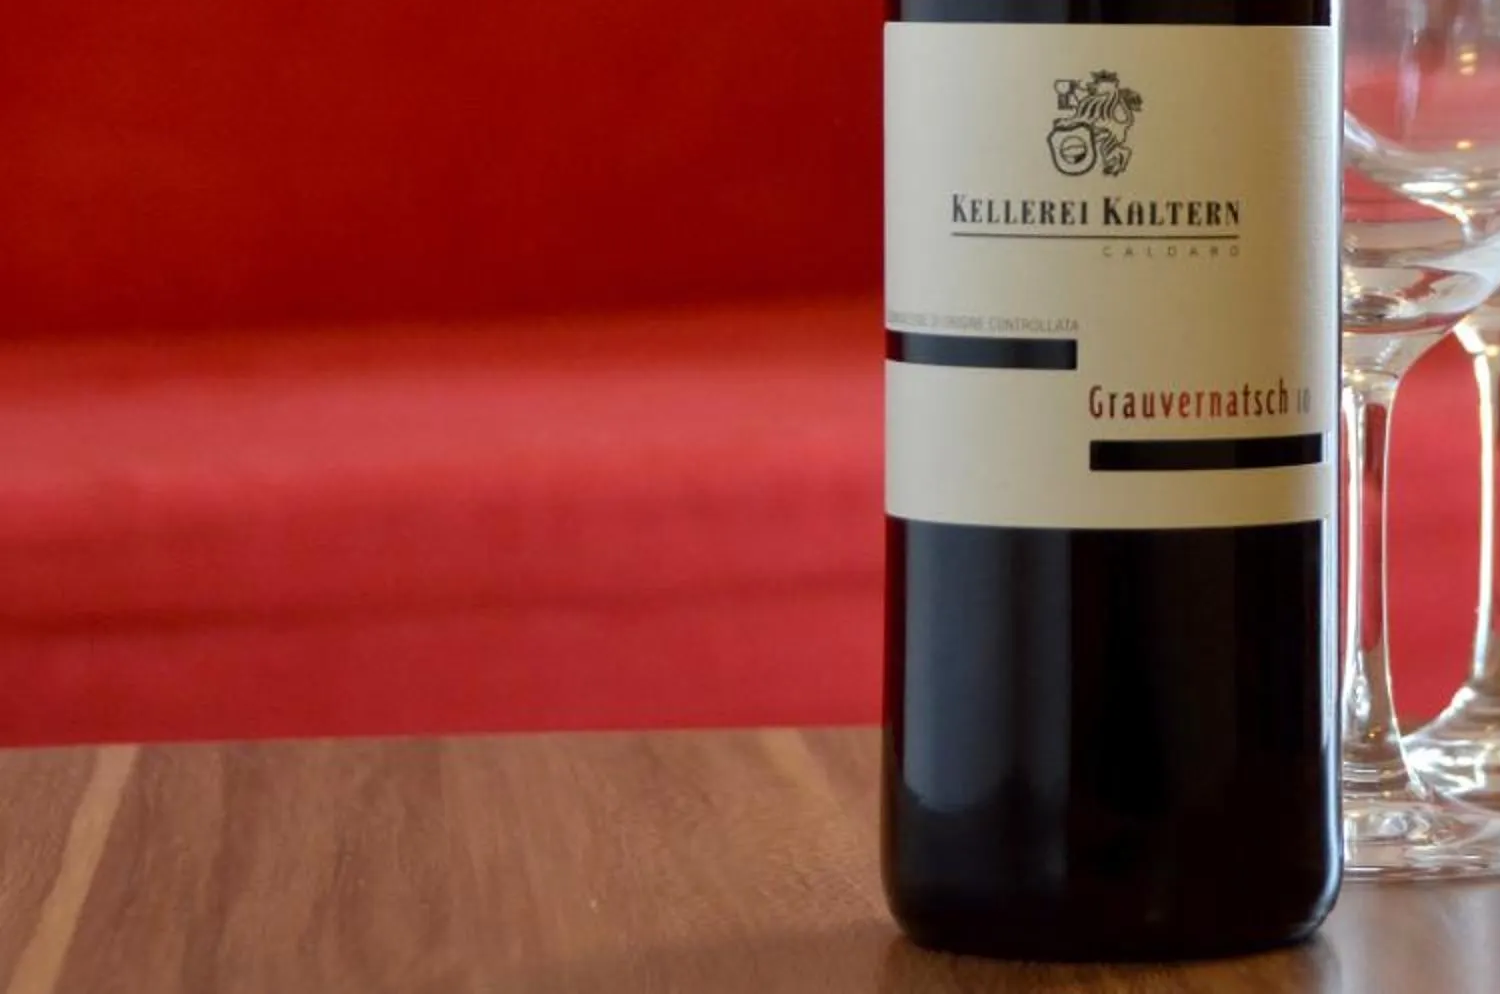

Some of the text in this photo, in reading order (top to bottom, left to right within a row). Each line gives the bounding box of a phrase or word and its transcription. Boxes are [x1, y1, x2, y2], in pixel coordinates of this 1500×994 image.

[951, 194, 1240, 227] KELLEREI KALTERN
[1102, 244, 1240, 259] CALDARO
[989, 315, 1079, 333] CONTROLLATA
[1088, 377, 1289, 420] Grauvernatsch
